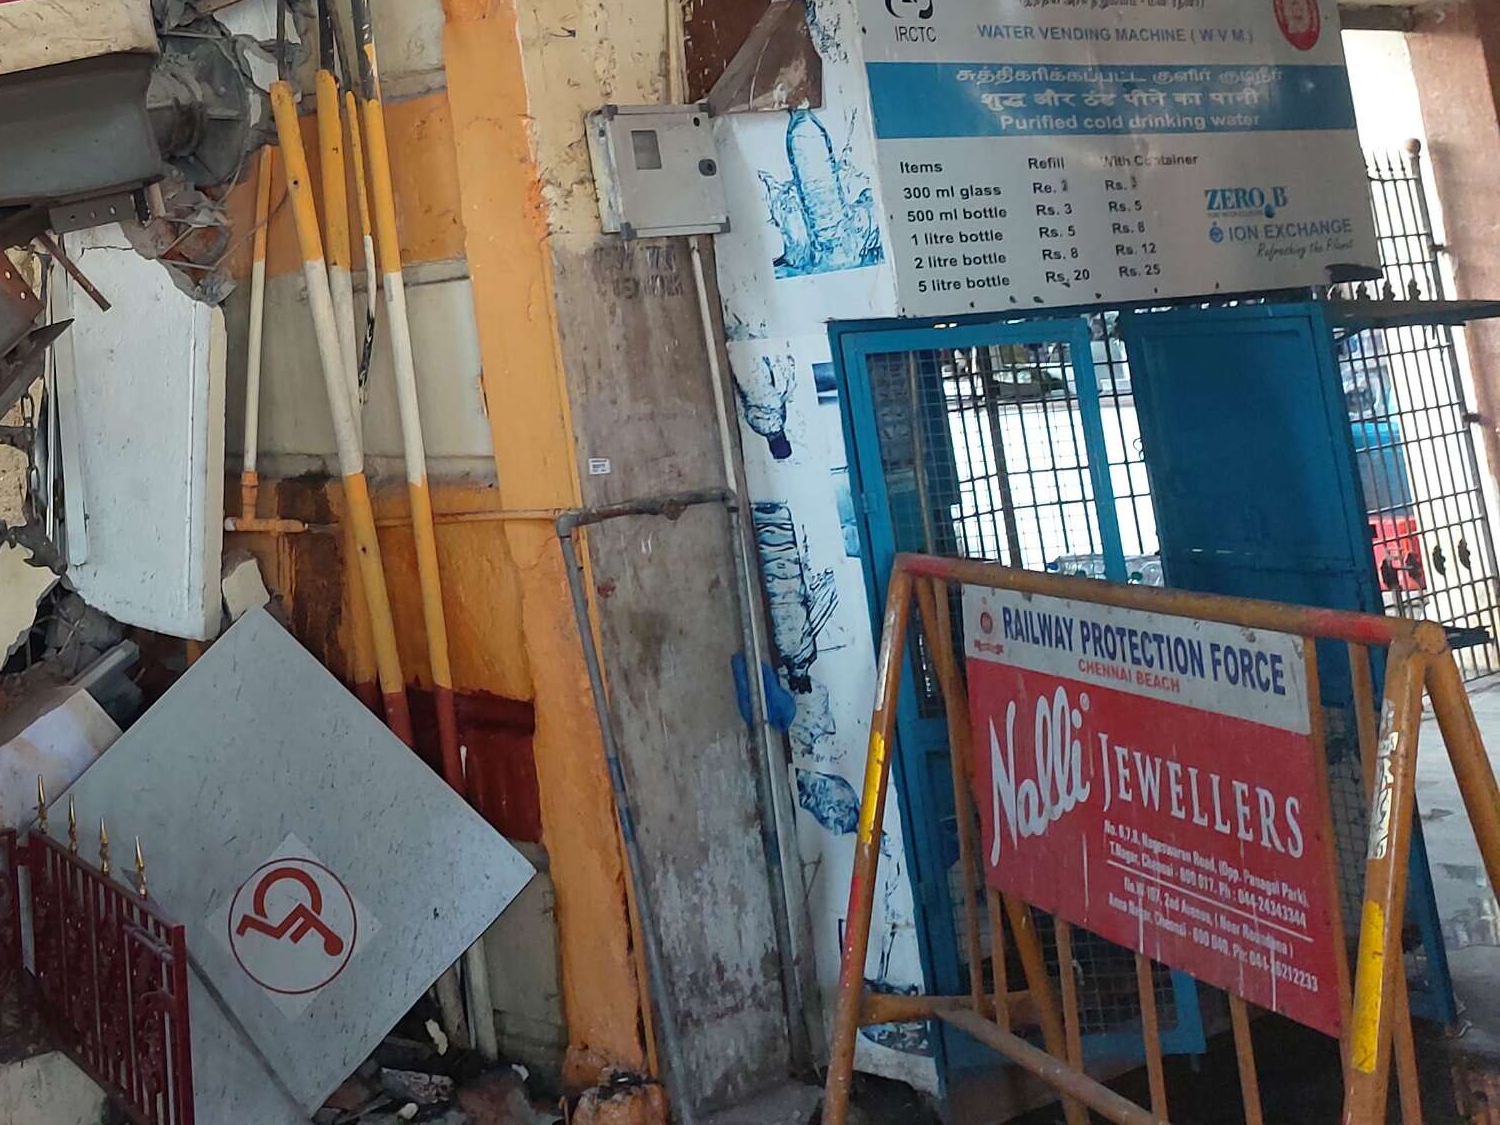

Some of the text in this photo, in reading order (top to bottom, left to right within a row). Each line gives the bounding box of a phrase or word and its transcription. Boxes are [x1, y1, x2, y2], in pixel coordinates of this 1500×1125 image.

[894, 26, 937, 42] IRCTC
[977, 24, 1034, 39] WATER
[1038, 26, 1110, 41] VENDING
[1115, 29, 1186, 43] MACHINE
[1001, 112, 1260, 131] Purified cold drinking water
[900, 161, 943, 174] Items
[1028, 157, 1065, 170] Refill
[903, 186, 931, 200] 300
[936, 185, 955, 198] ml
[960, 184, 1002, 200] glass
[1033, 181, 1057, 194] Re.
[1105, 179, 1127, 192] Rs.
[1204, 187, 1265, 210] ZERO
[907, 209, 934, 222] 500
[939, 208, 958, 221] ml
[963, 207, 1007, 220] bottle
[1036, 204, 1060, 216] Rs.
[1064, 203, 1073, 215] 3
[1108, 201, 1131, 213] Rs.
[910, 234, 919, 246] 1
[924, 232, 954, 245] litre
[959, 229, 1004, 243] bottle
[1039, 226, 1063, 238] Rs.
[1067, 225, 1076, 237] 5
[1112, 222, 1134, 235] Rs.
[1229, 219, 1353, 241] ION EXCHANGE
[914, 242, 1157, 269] 2 litre bottle Rs. 8 Rs. 12
[1309, 240, 1323, 253] the
[918, 263, 1161, 293] 5 litre bottle Rs. 20 Rs. 25
[1002, 606, 1286, 696] RAILWAY PROTECTION FORCE
[1078, 658, 1180, 694] CHENNAI BEACH
[989, 685, 1092, 867] Nalli
[1098, 732, 1303, 859] JEWELLERS
